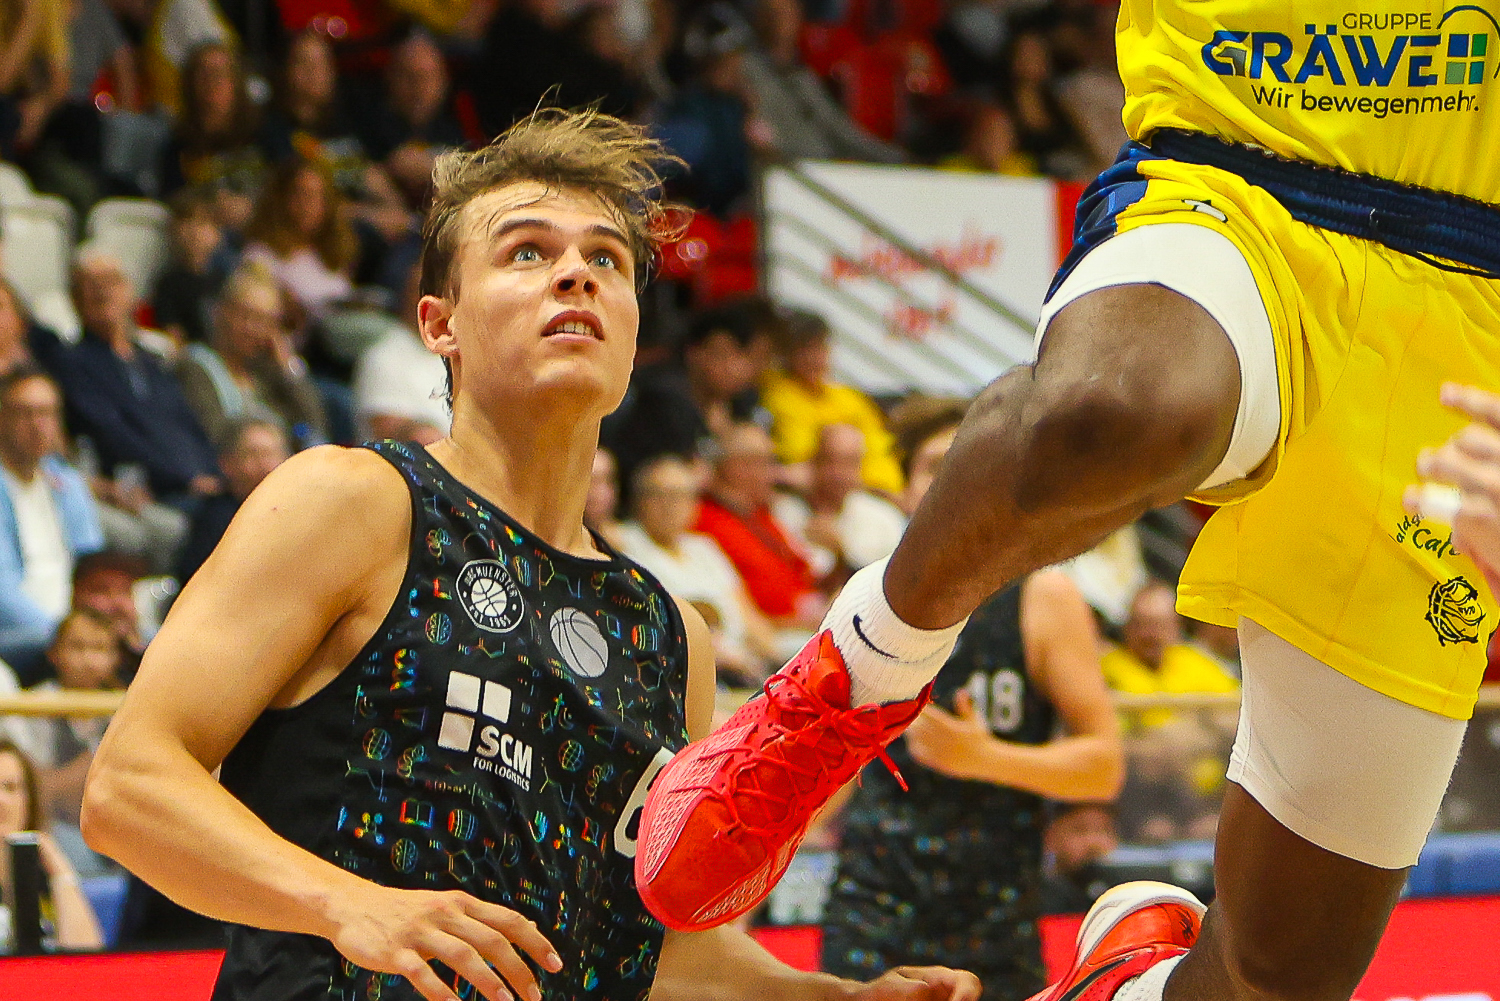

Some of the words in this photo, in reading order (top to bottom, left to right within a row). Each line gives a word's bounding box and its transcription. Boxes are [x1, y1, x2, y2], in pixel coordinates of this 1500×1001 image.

[1342, 12, 1432, 30] GRUPPE
[1201, 24, 1442, 87] GRÄWE
[1250, 84, 1294, 109] Wir
[476, 725, 533, 780] SCM
[473, 756, 493, 773] FOR
[494, 763, 531, 792] LOGISTICS
